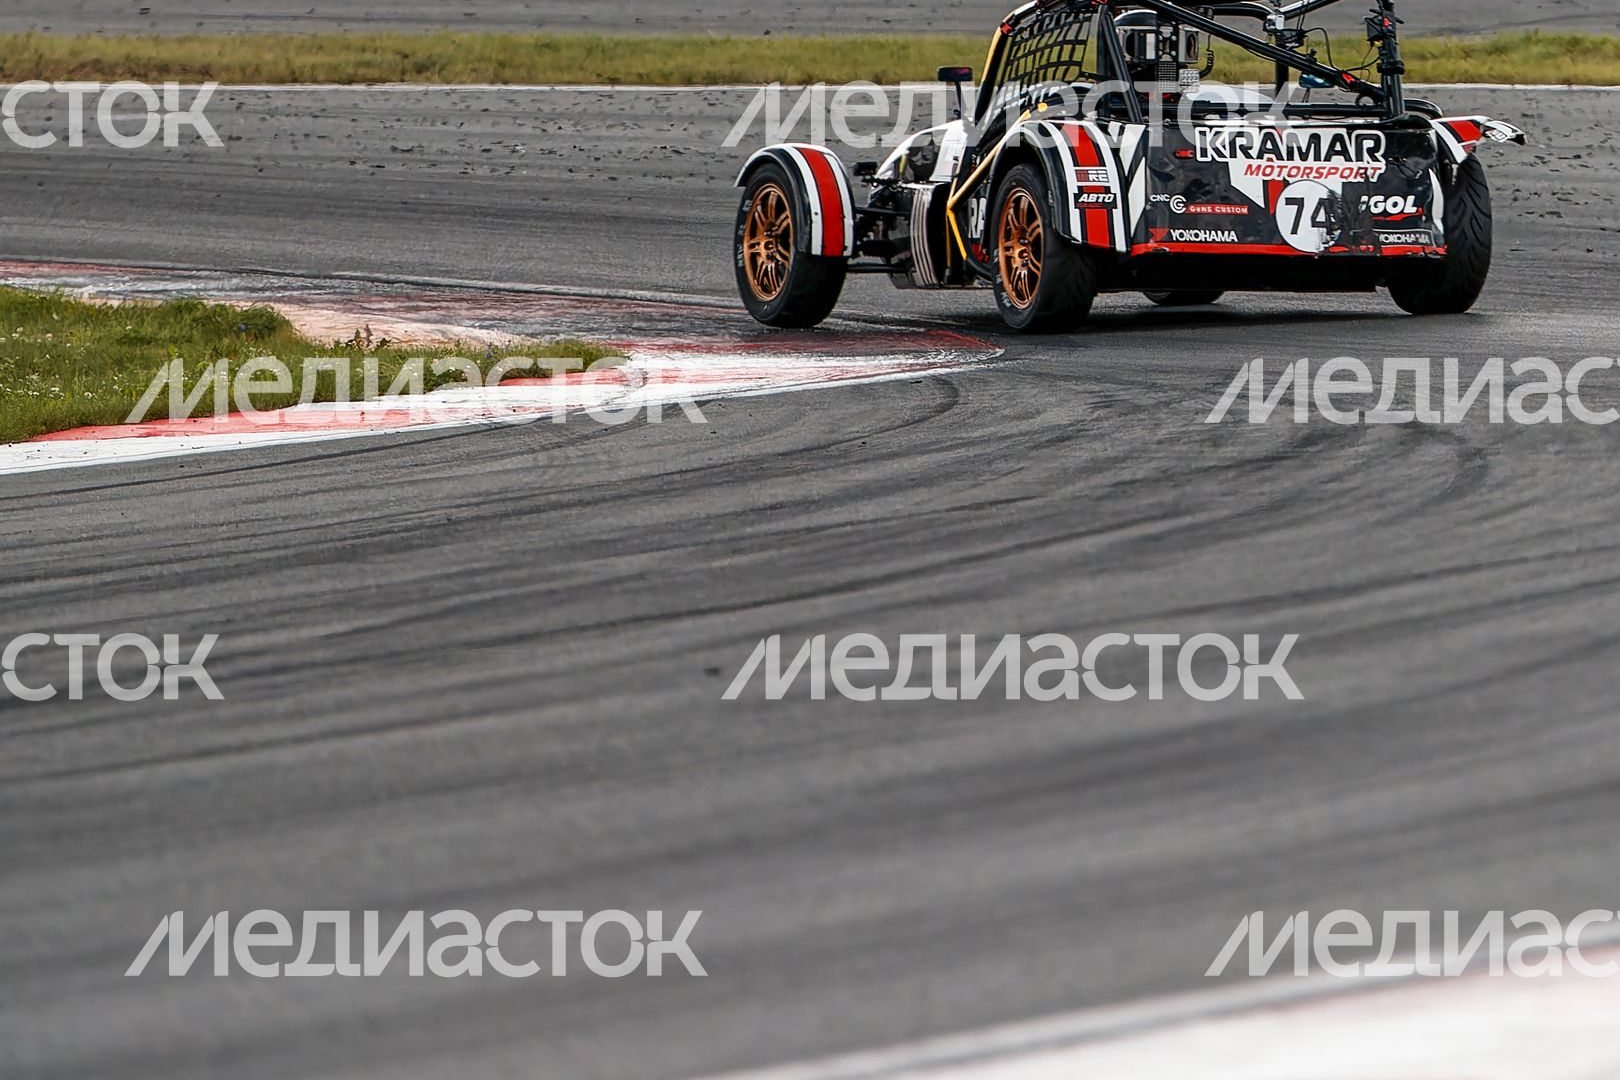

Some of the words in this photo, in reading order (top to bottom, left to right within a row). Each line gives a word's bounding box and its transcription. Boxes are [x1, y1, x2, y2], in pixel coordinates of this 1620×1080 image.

[1196, 128, 1385, 163] KRAMAR
[1243, 163, 1383, 181] MOTORSPORT
[1149, 193, 1171, 203] CNC
[1284, 197, 1335, 236] 74
[1169, 228, 1239, 242] YOKOHAMA
